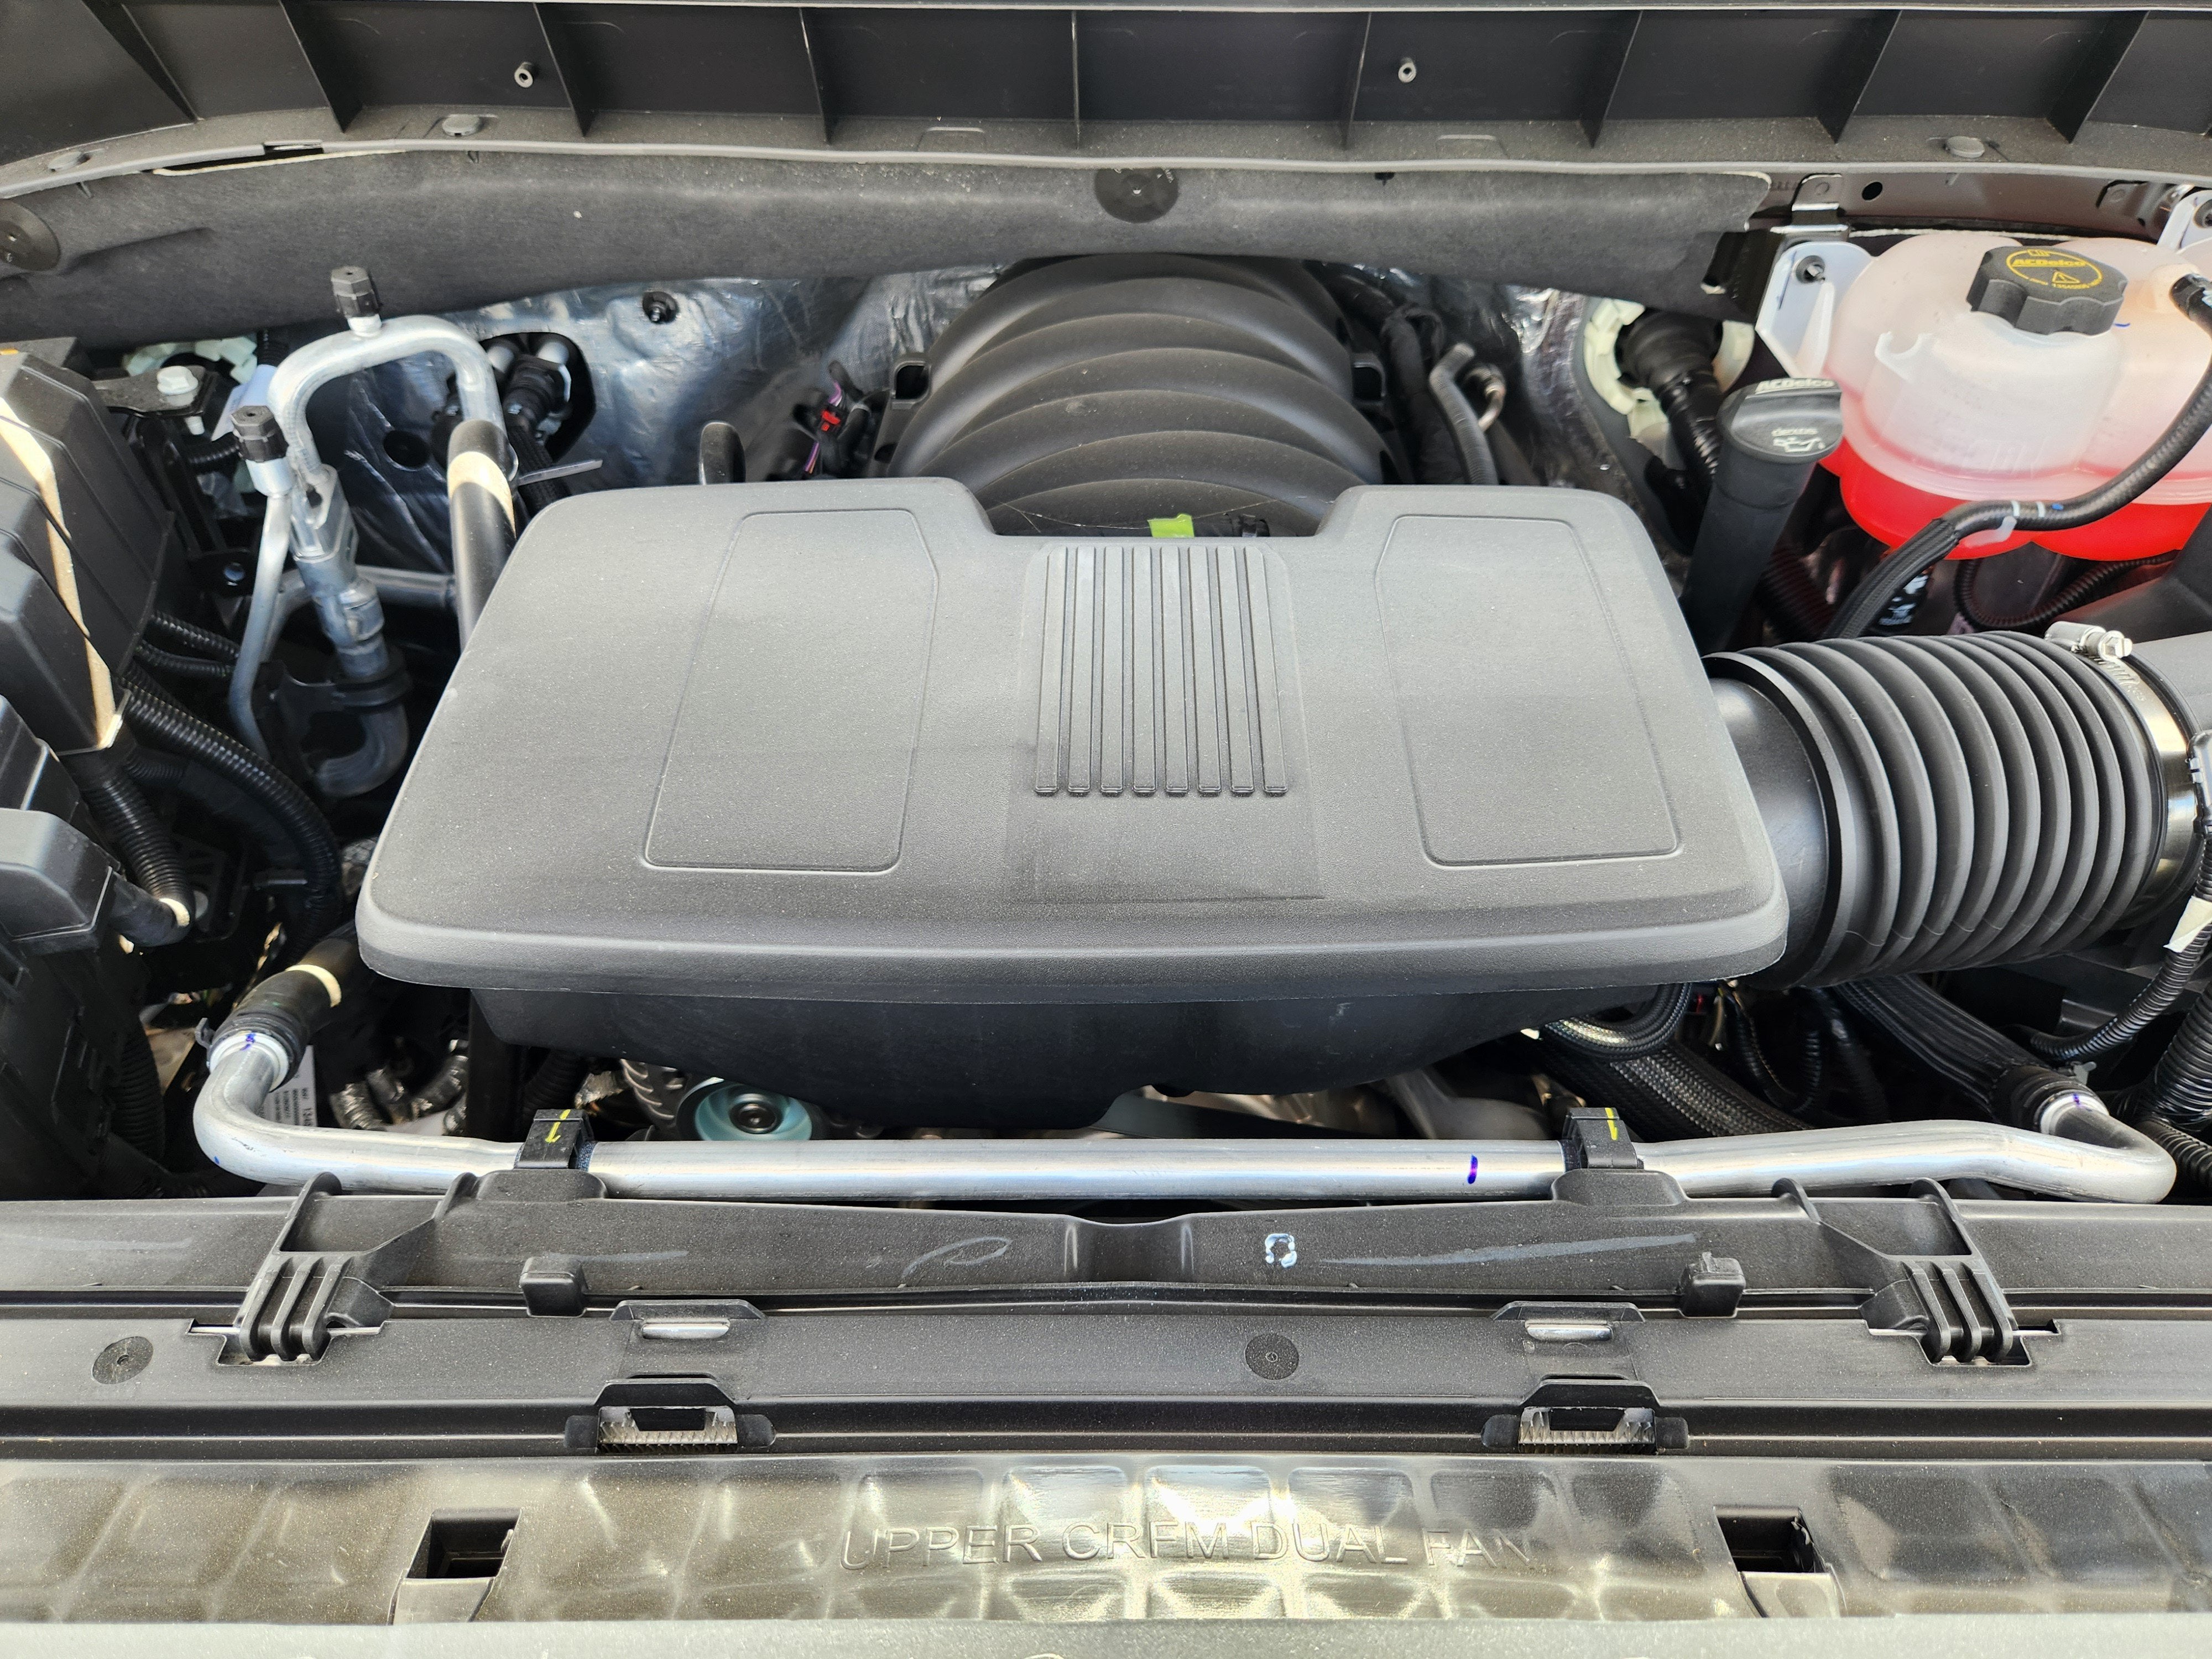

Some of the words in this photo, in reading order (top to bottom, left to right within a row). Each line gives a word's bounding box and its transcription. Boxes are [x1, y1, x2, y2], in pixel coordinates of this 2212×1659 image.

[1755, 378, 1836, 395] ACDelco
[839, 1524, 1043, 1571] UPPER
[1062, 1520, 1230, 1561] CRFM
[1250, 1521, 1409, 1565] DUAL
[1422, 1527, 1534, 1569] FAN
